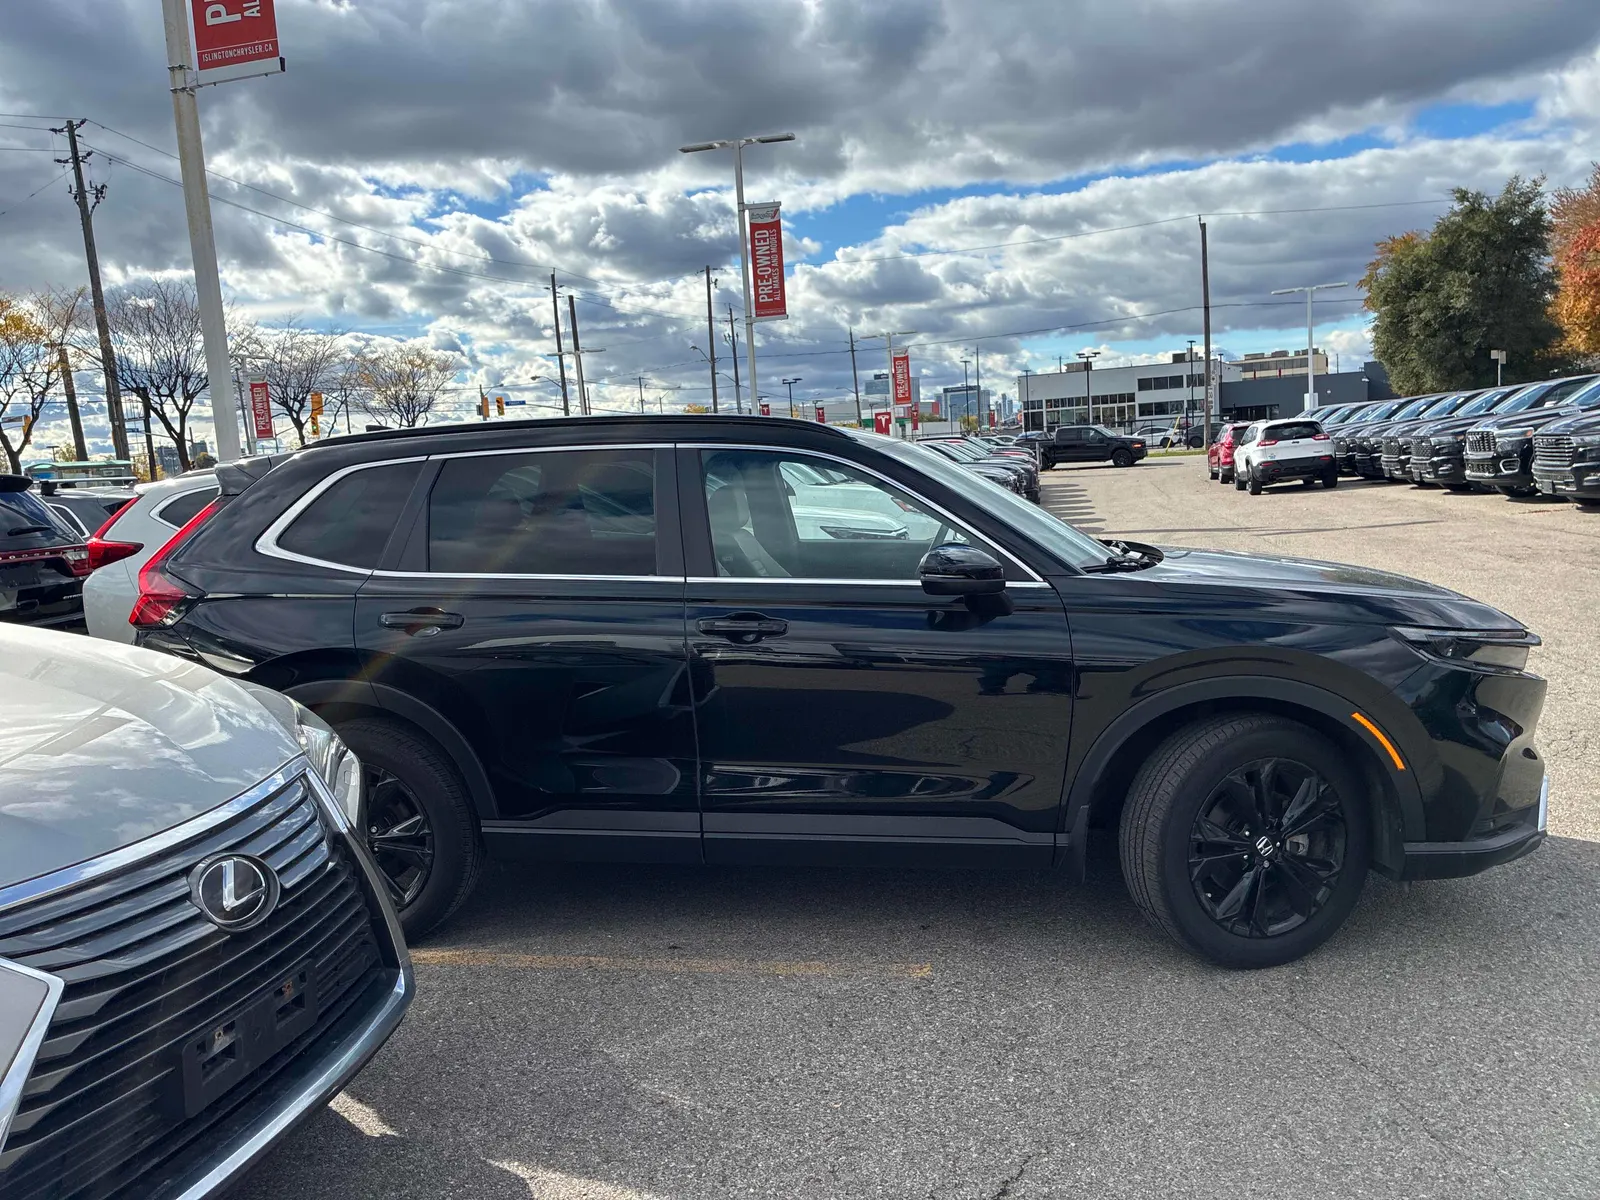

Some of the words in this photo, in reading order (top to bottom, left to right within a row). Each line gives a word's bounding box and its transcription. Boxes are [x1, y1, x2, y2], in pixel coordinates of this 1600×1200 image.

[202, 43, 273, 62] ISLINGTONCHRYSLER.CA
[769, 228, 777, 254] MODELS
[755, 229, 774, 302] PRE-OWNED
[770, 254, 778, 267] AND
[772, 268, 780, 290] MAKES
[896, 360, 906, 398] PRE-OWNED
[253, 388, 266, 430] PRE-OWNED
